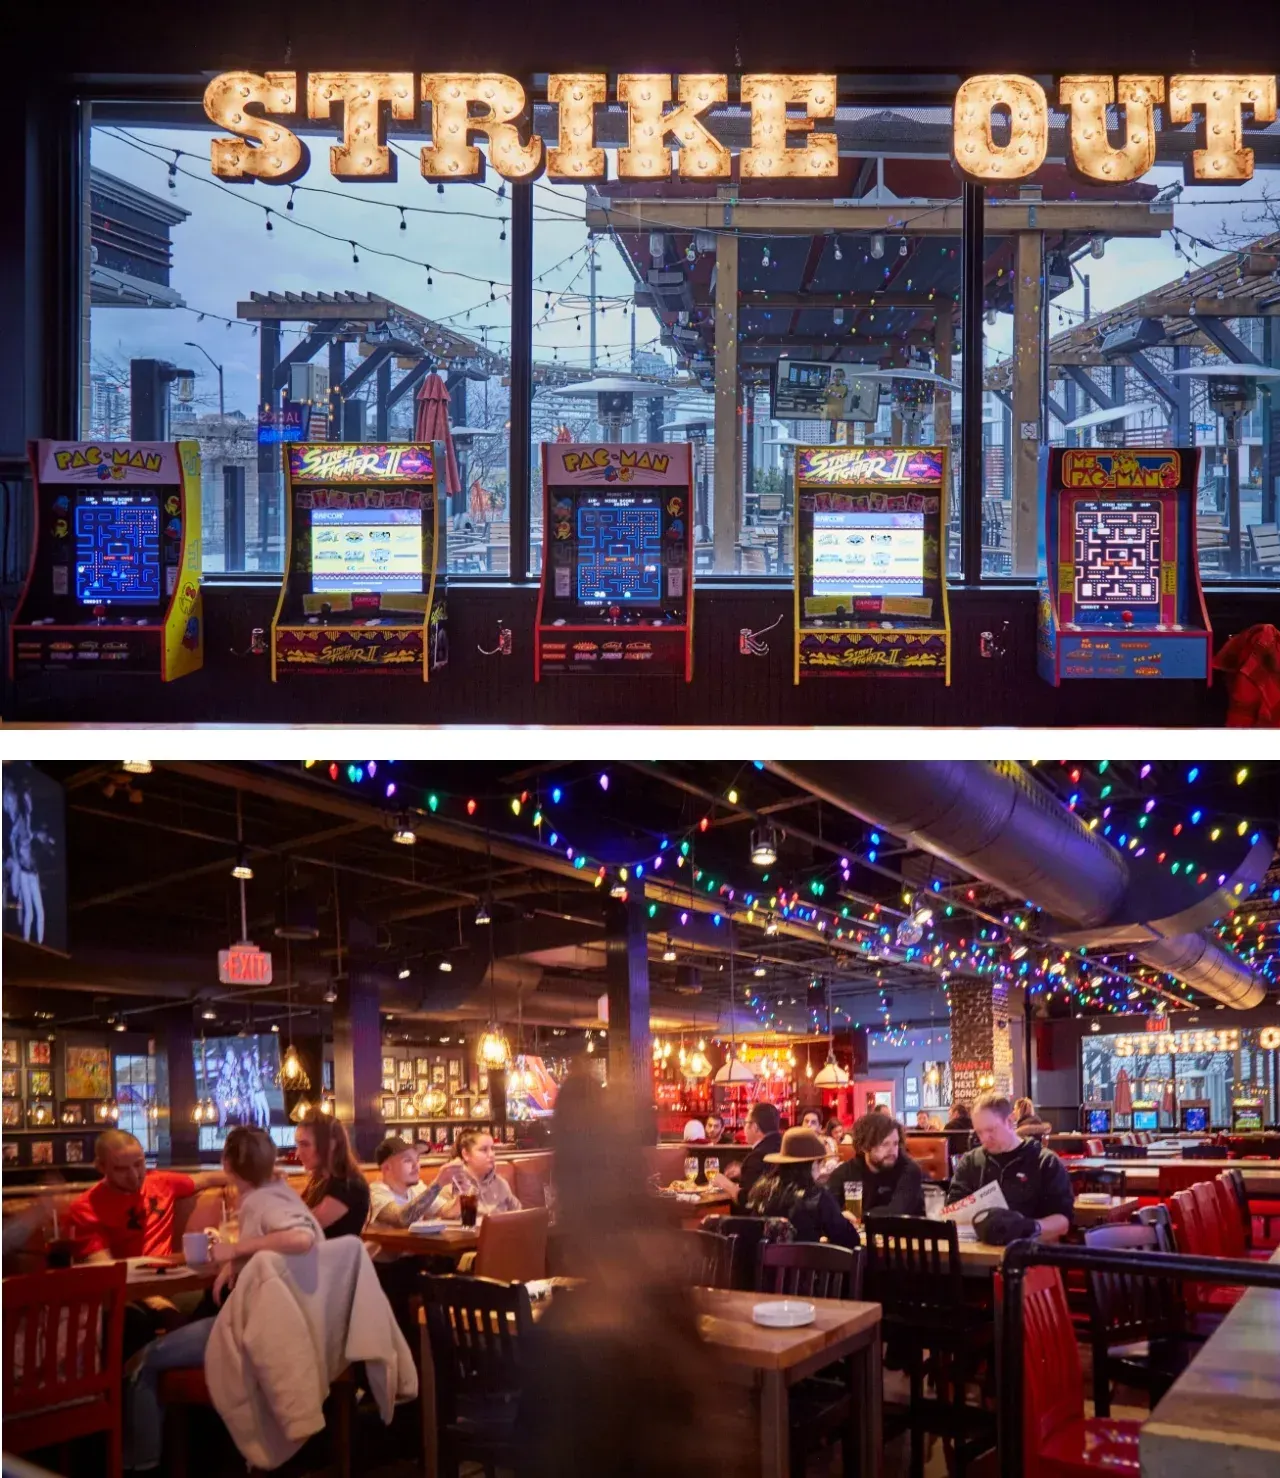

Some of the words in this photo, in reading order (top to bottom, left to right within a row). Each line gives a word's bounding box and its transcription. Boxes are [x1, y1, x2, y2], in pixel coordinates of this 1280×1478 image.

[203, 71, 839, 182] STRIKE
[952, 73, 1278, 183] OUT
[54, 446, 162, 473] PAC-MAN
[300, 445, 358, 478] STREET
[313, 453, 387, 479] FIGHTER
[562, 448, 669, 474] PAC-MAN
[803, 450, 864, 479] STREET
[817, 457, 893, 482] FIGHTER
[1071, 469, 1160, 486] PAC-MAN
[229, 951, 265, 980] EXIT
[1114, 1028, 1239, 1057] STRIKE
[954, 1071, 975, 1080] PICK
[954, 1081, 976, 1089] NEXT
